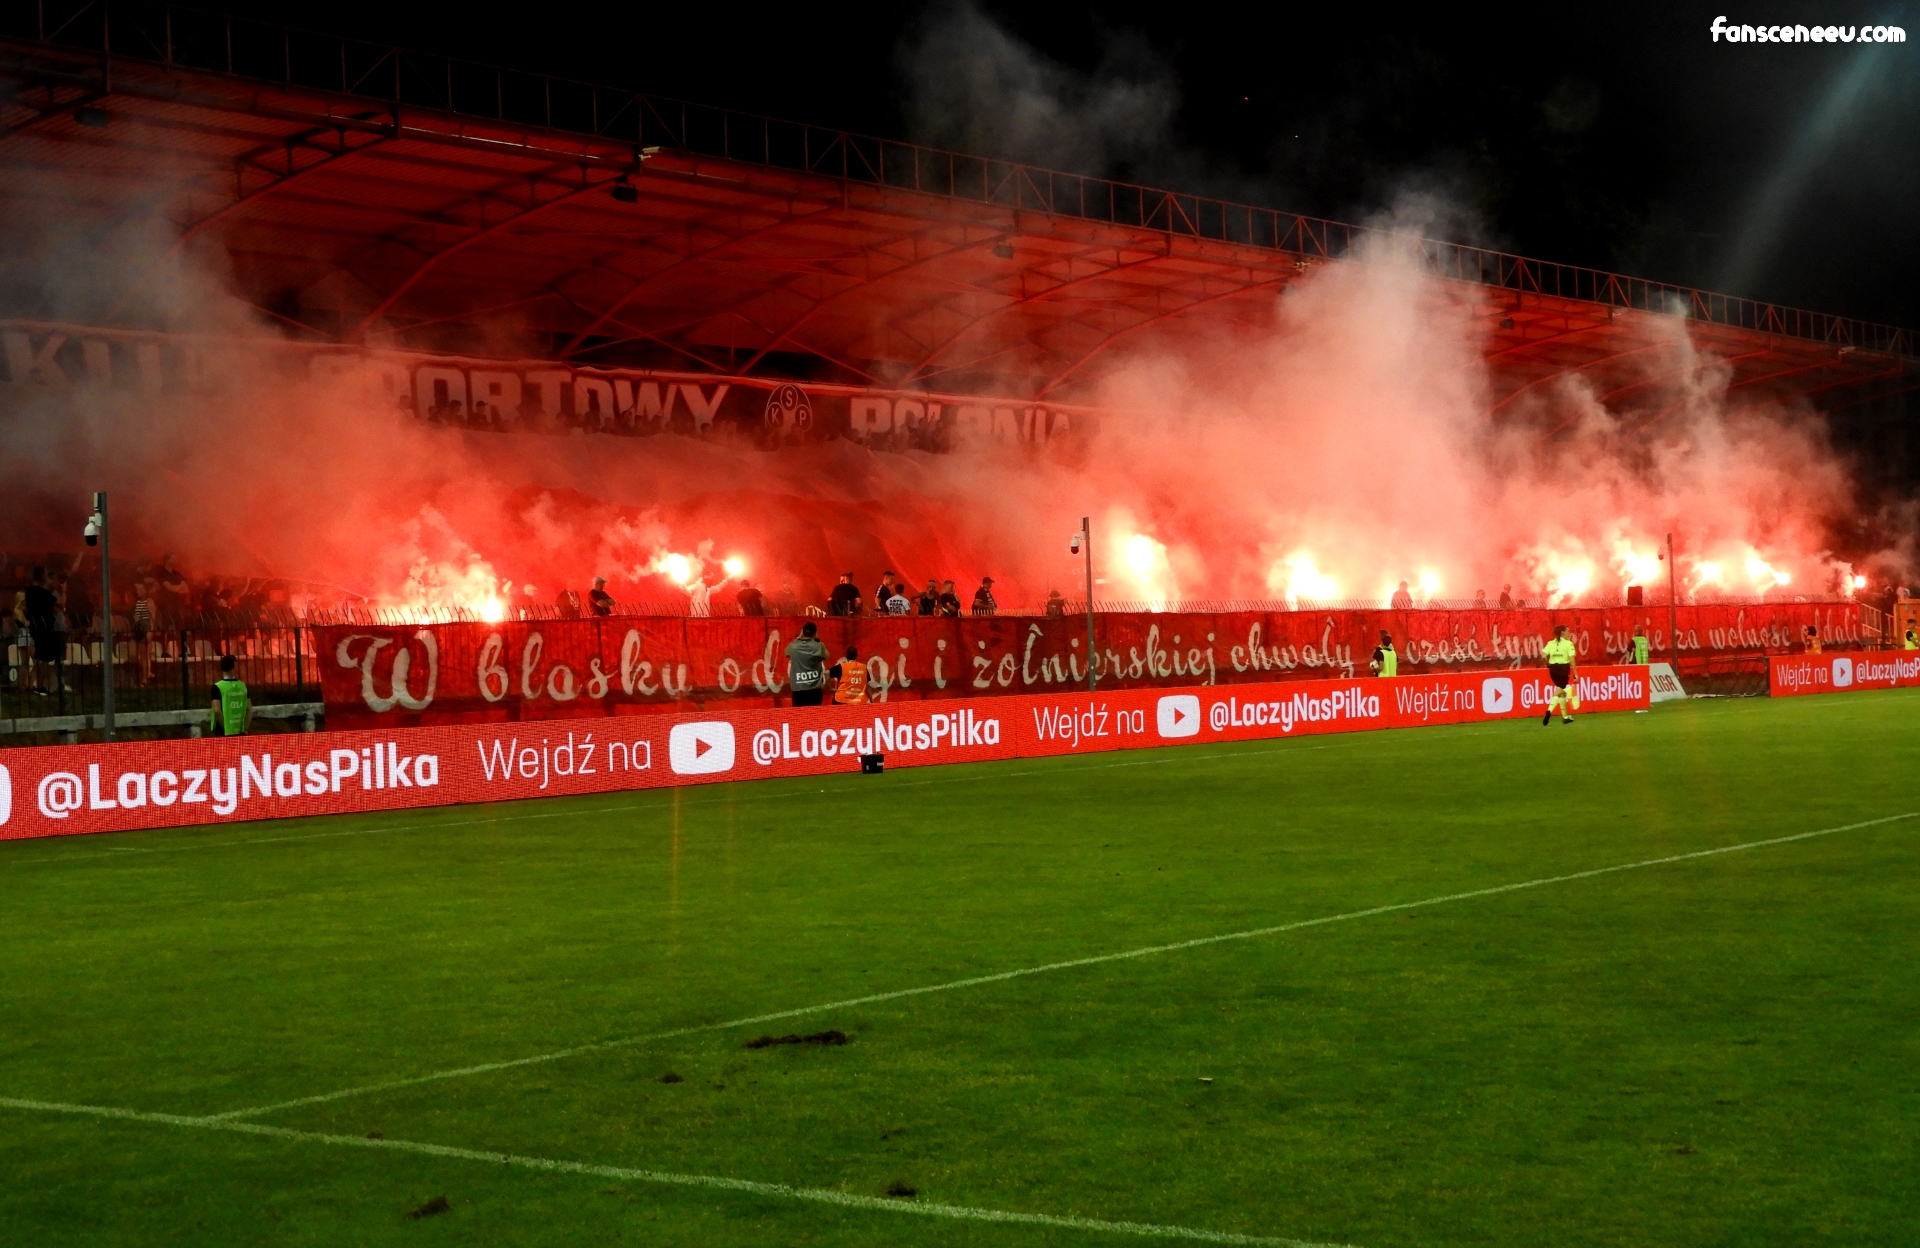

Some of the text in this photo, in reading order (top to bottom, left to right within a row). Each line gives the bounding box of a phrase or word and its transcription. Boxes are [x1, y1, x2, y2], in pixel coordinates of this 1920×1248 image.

[335, 630, 438, 713] W
[478, 628, 692, 703] blasku
[717, 629, 912, 704] odgi
[933, 638, 947, 690] i
[796, 670, 819, 681] FOTO
[1395, 672, 1643, 721] Wejdź na @LaNasPilka
[1776, 662, 1812, 692] Wejdź
[1814, 667, 1828, 684] na
[1033, 687, 1381, 748] Wejdź na @LaczyNasPilka
[477, 708, 1001, 790] Wejdź na @LaczyNasPilka
[37, 741, 439, 820] @LaczyNasPilka
